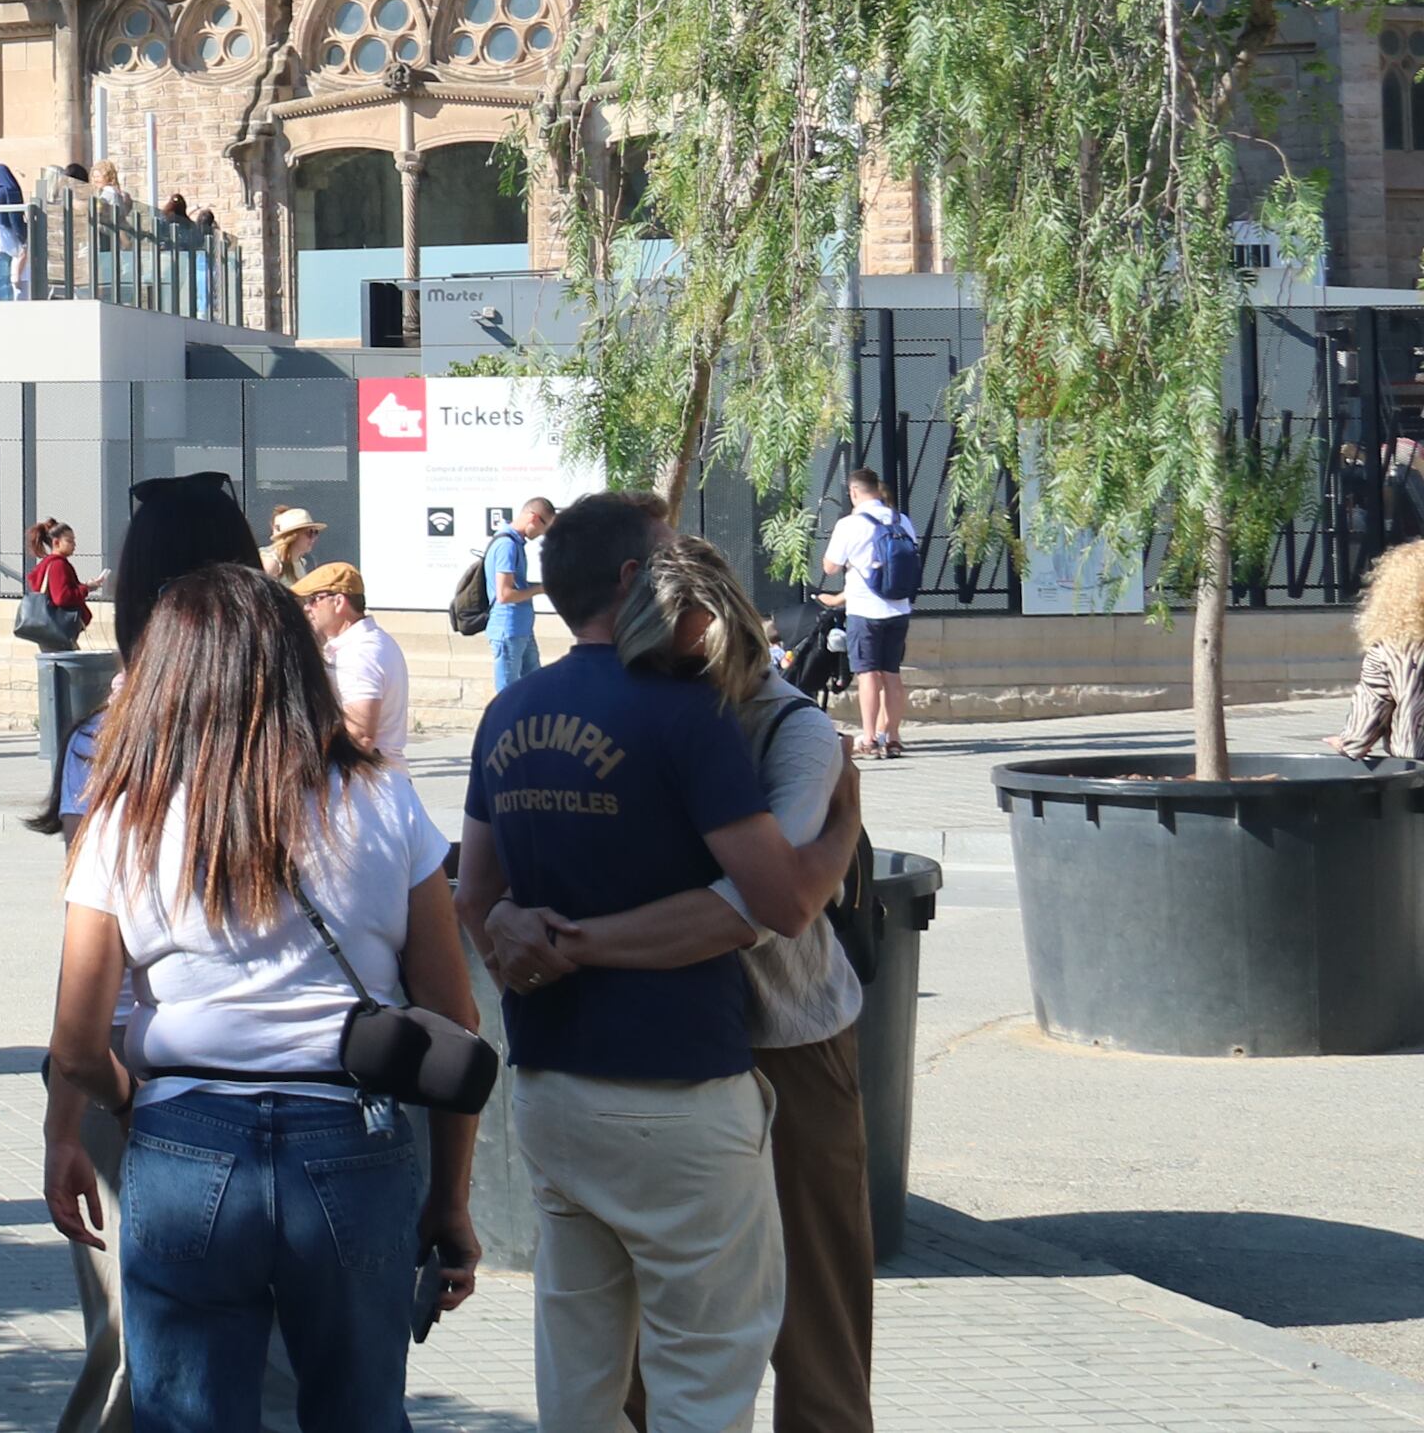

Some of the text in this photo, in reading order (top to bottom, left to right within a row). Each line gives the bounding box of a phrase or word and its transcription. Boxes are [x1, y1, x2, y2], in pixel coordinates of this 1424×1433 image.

[427, 288, 483, 301] Master
[439, 406, 524, 427] Tickets
[485, 713, 626, 780] TRIUMPH
[495, 788, 618, 815] MOTORCYCLES
